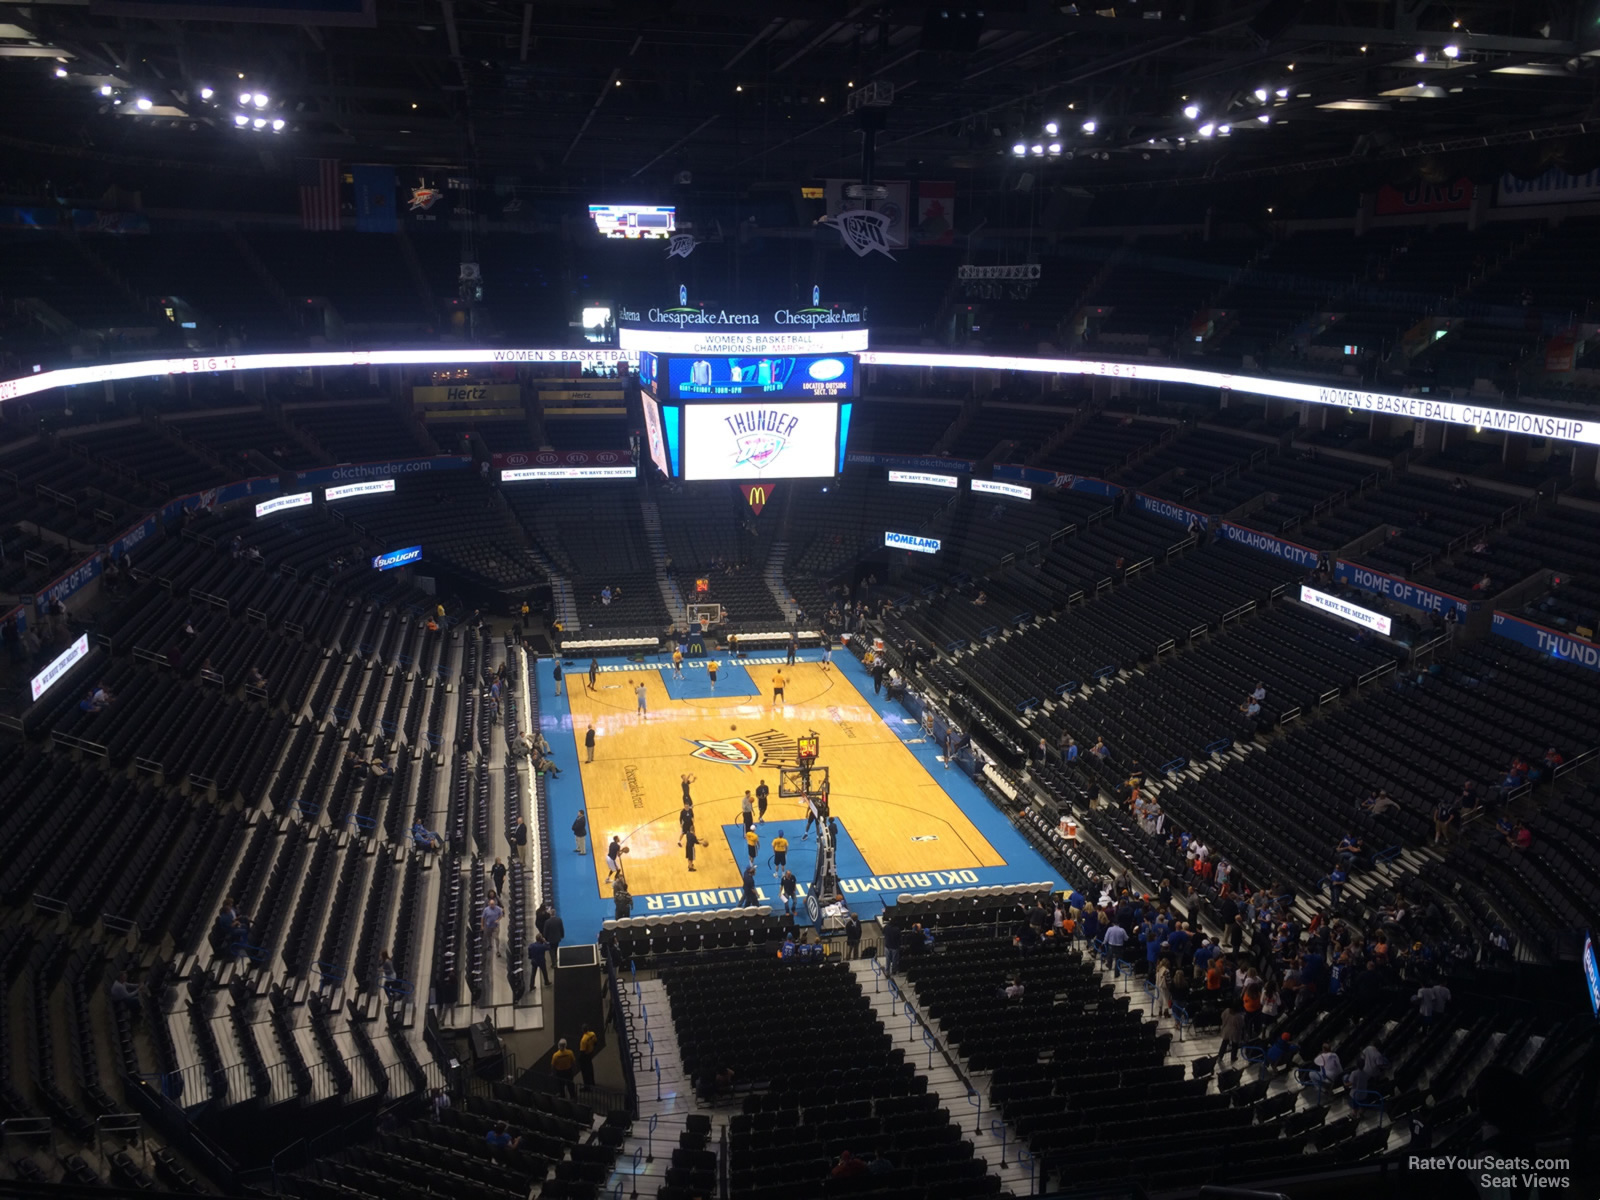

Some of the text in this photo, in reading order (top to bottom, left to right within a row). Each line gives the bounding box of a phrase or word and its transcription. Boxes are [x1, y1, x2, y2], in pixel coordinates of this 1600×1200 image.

[648, 308, 760, 329] Chesapeake Arena
[774, 309, 841, 329] Chesapeake
[841, 310, 860, 323] Arena
[756, 335, 812, 344] BASKETBALL
[561, 351, 641, 361] BASKETBALL
[694, 344, 767, 353] CHAMPIONSHIP
[193, 357, 237, 371] BIG 12
[1101, 363, 1137, 378] BIG 12
[447, 387, 487, 400] Hertz
[802, 381, 847, 390] LOCATED OUTSIDE
[572, 391, 592, 399] Hertz
[724, 409, 799, 438] THUNDER
[1377, 396, 1457, 422] BASKETBALL
[1462, 407, 1584, 440] CHAMPIONSHIP
[332, 459, 432, 480] okcthunder.com
[1144, 497, 1183, 522] WELCOME
[886, 533, 939, 549] HOMELAND
[1228, 526, 1308, 563] OKLAHOMA CITY
[379, 550, 420, 567] BUD LIGHT
[70, 573, 80, 589] OF
[80, 562, 93, 582] THE
[1354, 569, 1443, 612] HOME OF THE
[1315, 595, 1324, 603] WE
[1324, 597, 1340, 608] HAVE
[1340, 604, 1352, 614] THE
[1352, 609, 1373, 623] MEATS
[1456, 602, 1467, 612] 116
[1492, 614, 1505, 625] 117
[1536, 630, 1600, 669] THUND
[801, 745, 816, 757] 24
[841, 869, 979, 893] OKLAHOMA
